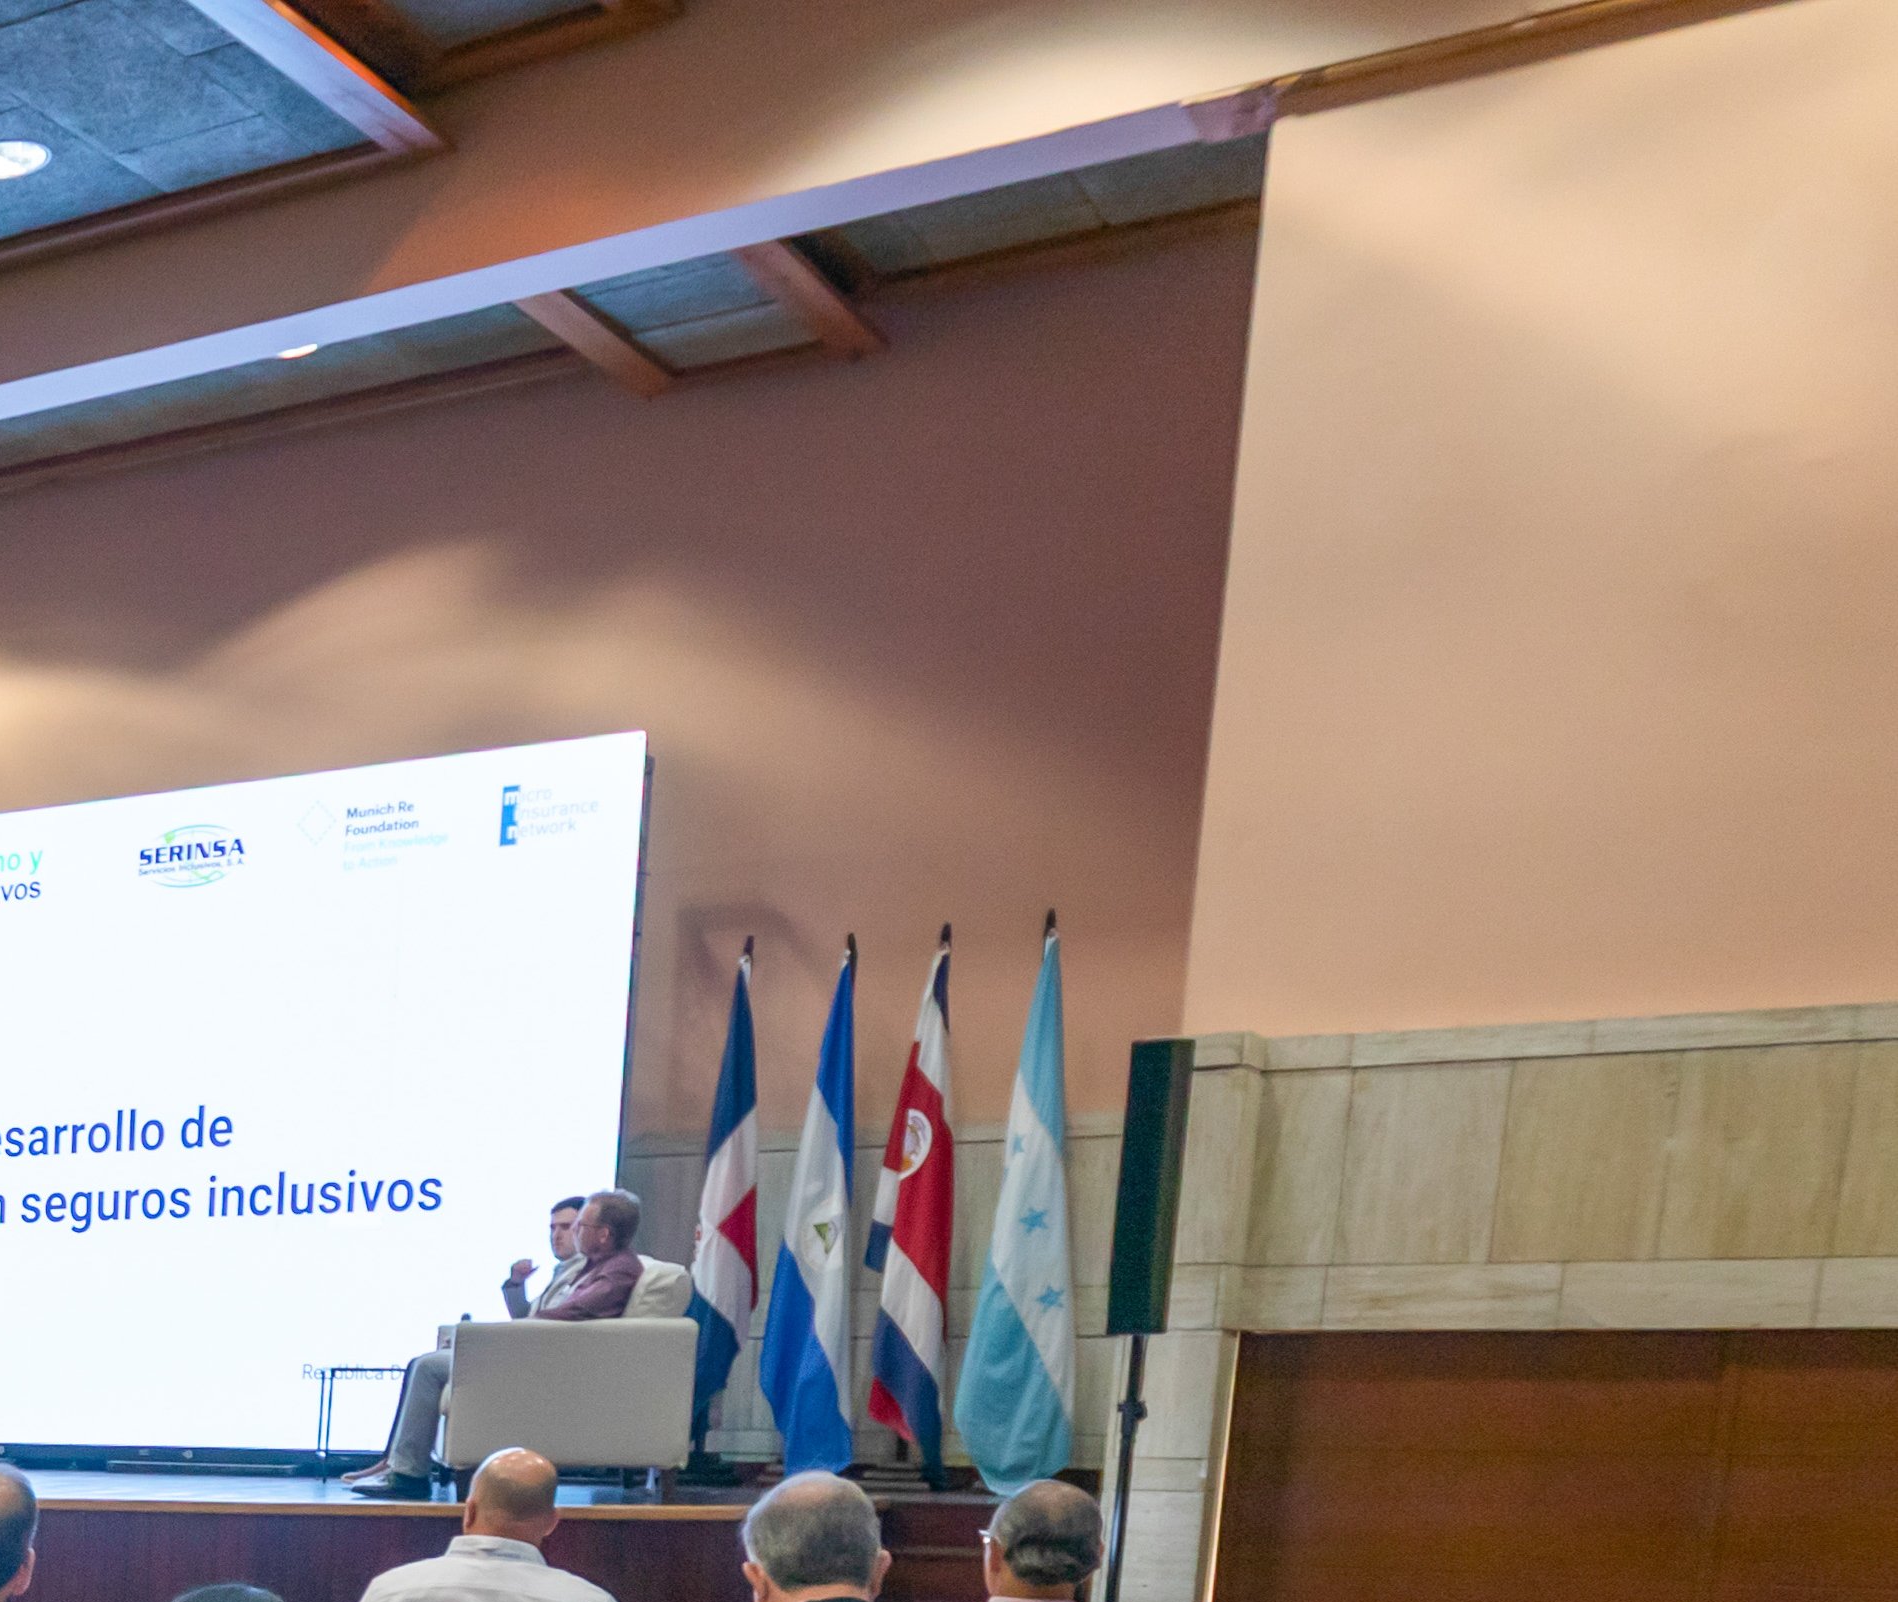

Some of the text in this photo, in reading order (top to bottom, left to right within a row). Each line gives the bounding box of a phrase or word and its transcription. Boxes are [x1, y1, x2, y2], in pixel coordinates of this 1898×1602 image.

[346, 801, 415, 819] Munich Re
[345, 818, 420, 837] Foundation
[29, 850, 44, 874] y
[139, 838, 245, 867] SERINSA
[179, 1104, 235, 1149] de
[20, 1186, 192, 1233] seguros
[207, 1168, 444, 1218] inclusivos
